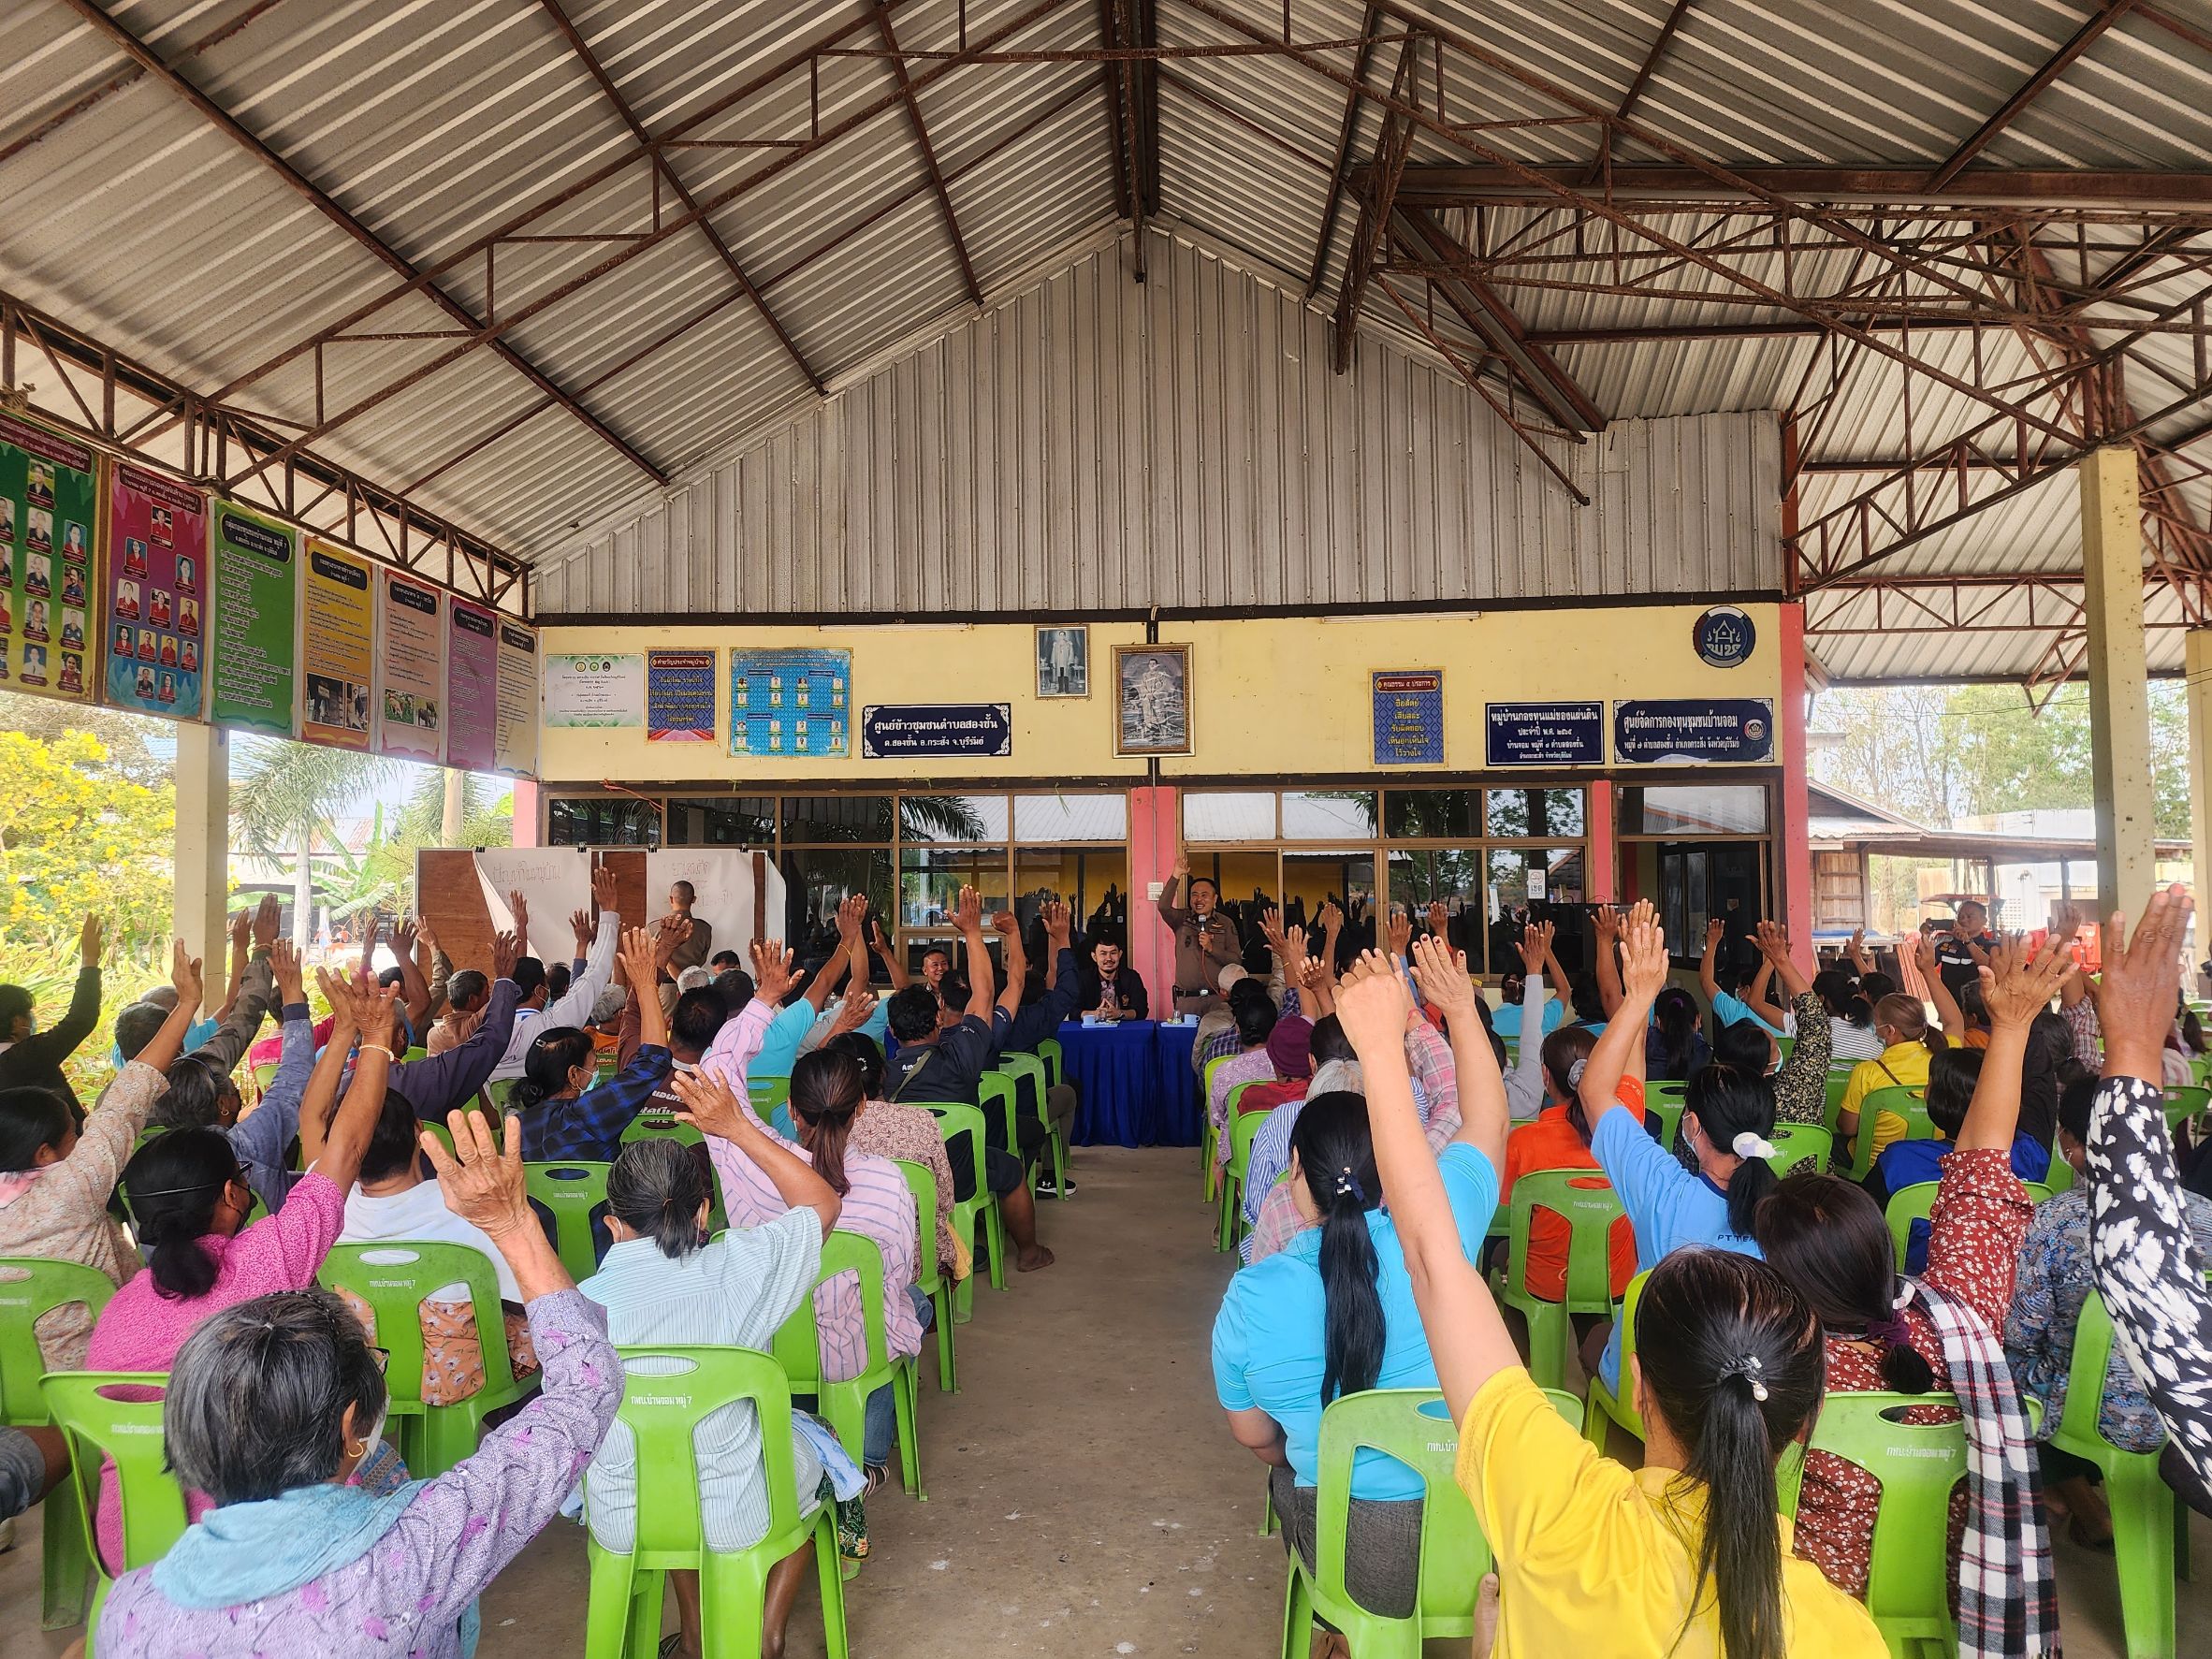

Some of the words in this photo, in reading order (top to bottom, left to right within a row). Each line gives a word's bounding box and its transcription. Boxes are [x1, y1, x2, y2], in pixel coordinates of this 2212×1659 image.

[874, 714, 998, 735] ศูนย์ข้าวชุมชนตำบลสองชั้น
[1491, 708, 1598, 726] หมู่บ้านกองทุนแม่ของแผ่นดิน
[1623, 709, 1739, 735] ศูนย์จัดการกองทุนชุมชนบ้านจอม
[1518, 726, 1541, 735] ประจำปี
[884, 735, 917, 747] ต.สองชั้น
[920, 737, 950, 747] อ.กระสัง
[952, 735, 984, 749] จ.บุรีรัมย์
[1506, 739, 1530, 749] บ้านจอม
[1643, 734, 1674, 749] ตำบลสองชั้น
[1675, 737, 1706, 749] อำเภอกระสัง
[1708, 736, 1740, 752] จังหวัดบุรีรัมย์
[631, 1392, 675, 1405] กทบ.บ้านจอม
[675, 1392, 687, 1409] หมู่
[686, 1396, 692, 1405] 7
